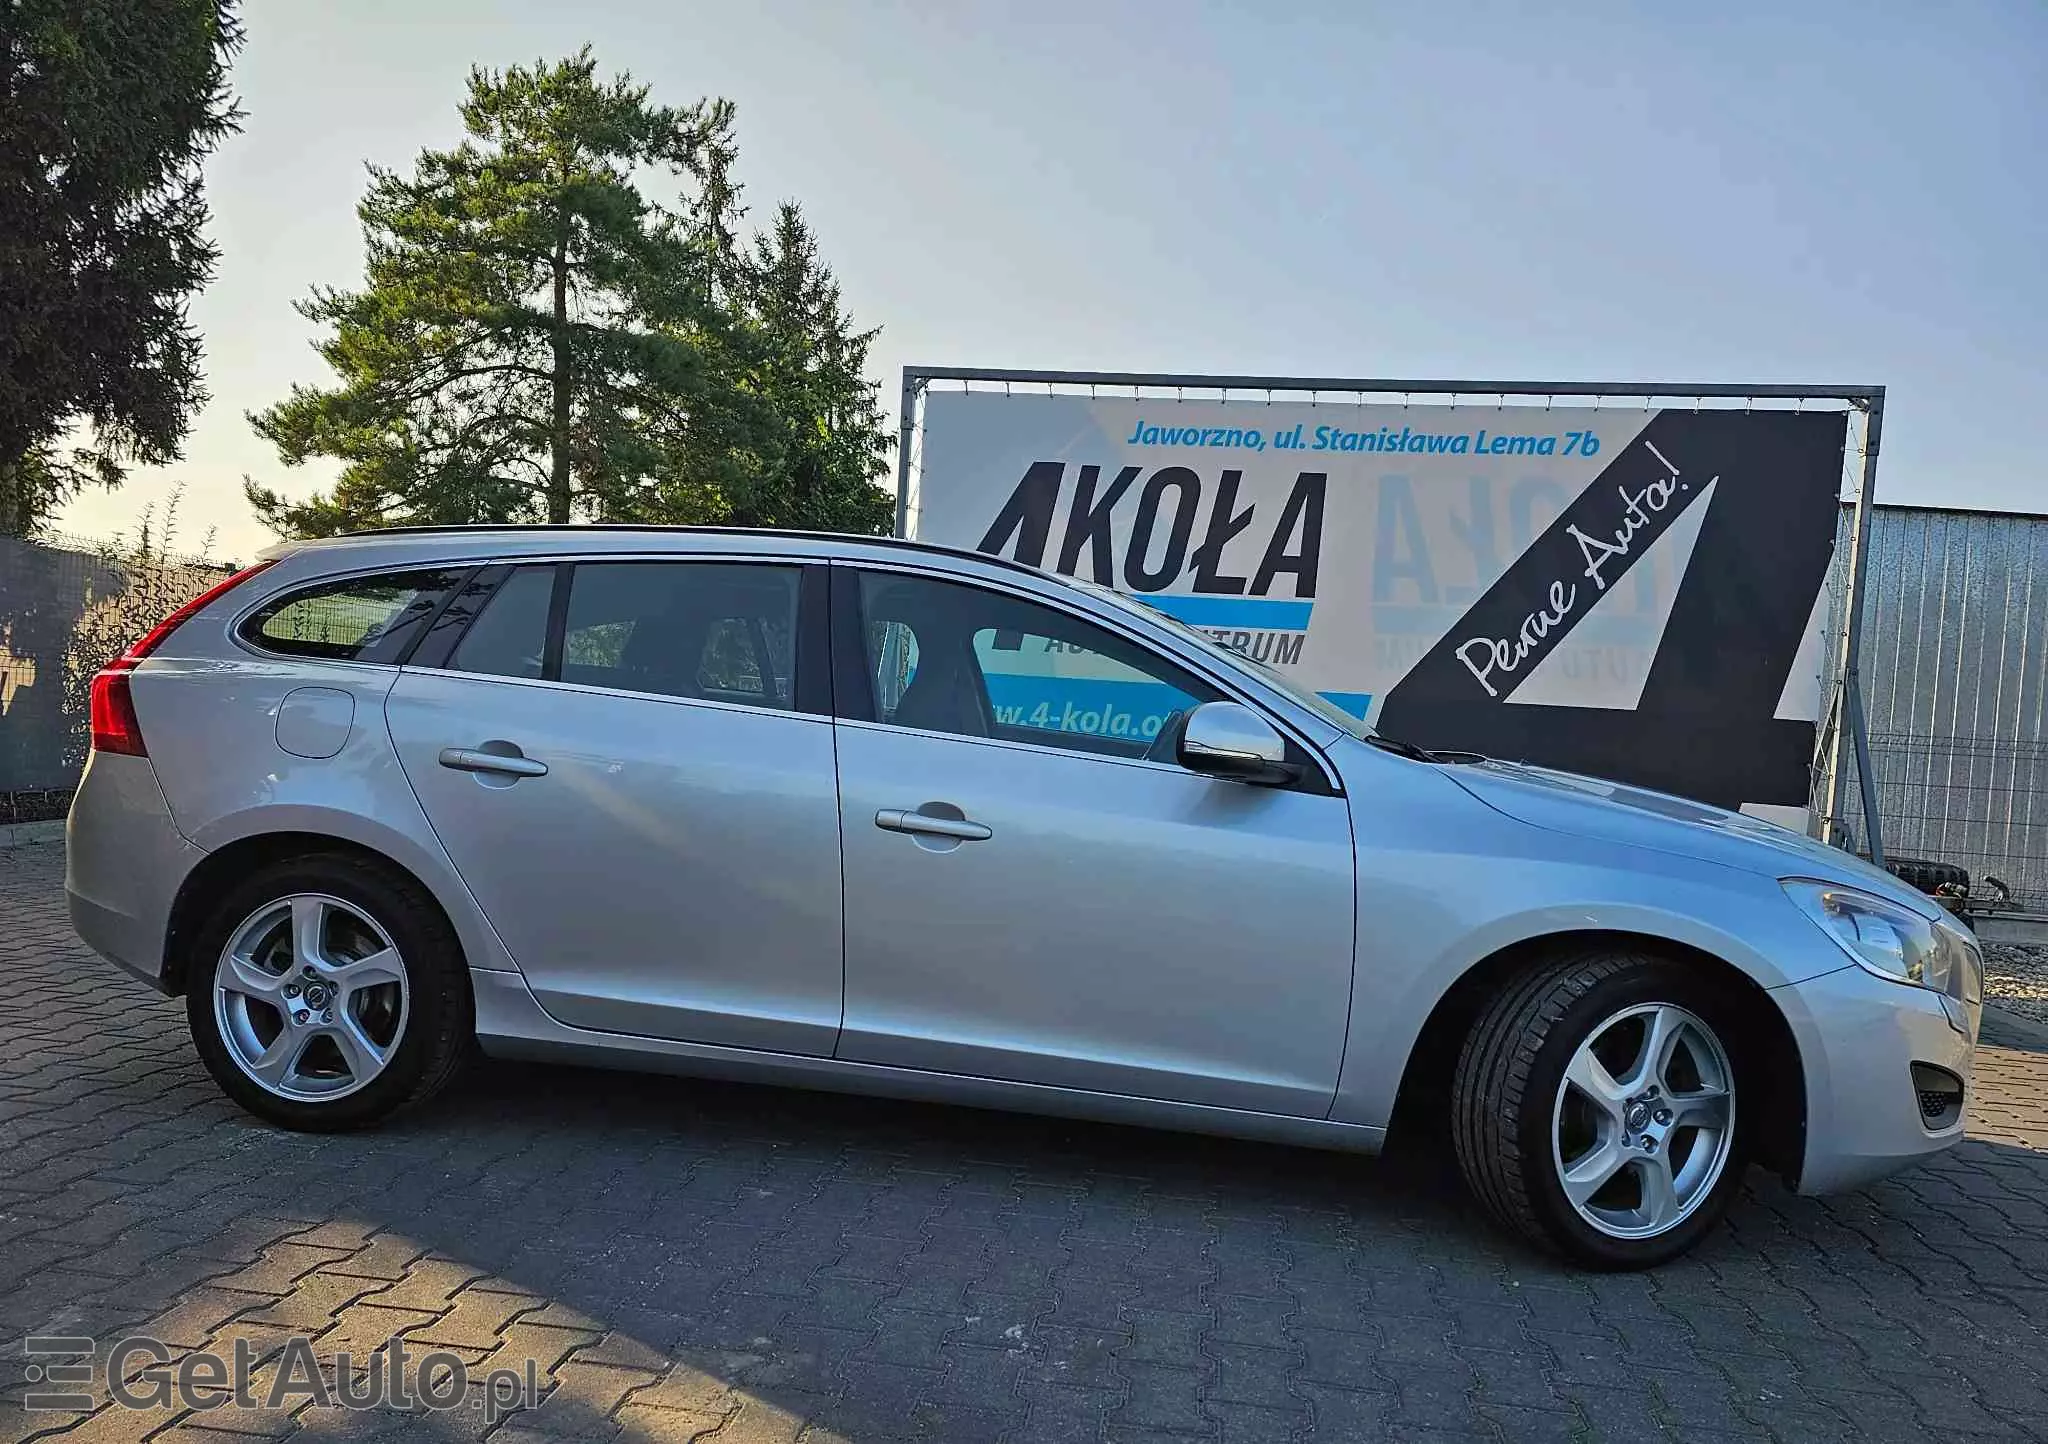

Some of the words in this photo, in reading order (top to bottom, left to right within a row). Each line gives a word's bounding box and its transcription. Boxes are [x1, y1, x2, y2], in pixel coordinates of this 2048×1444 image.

[1127, 420, 1267, 453] Jaworzno,
[1274, 425, 1306, 450] ul.
[1311, 426, 1468, 455] Stanisława
[1474, 430, 1556, 456] Lema
[1564, 432, 1601, 457] 7b
[1566, 440, 1690, 590] Auta!
